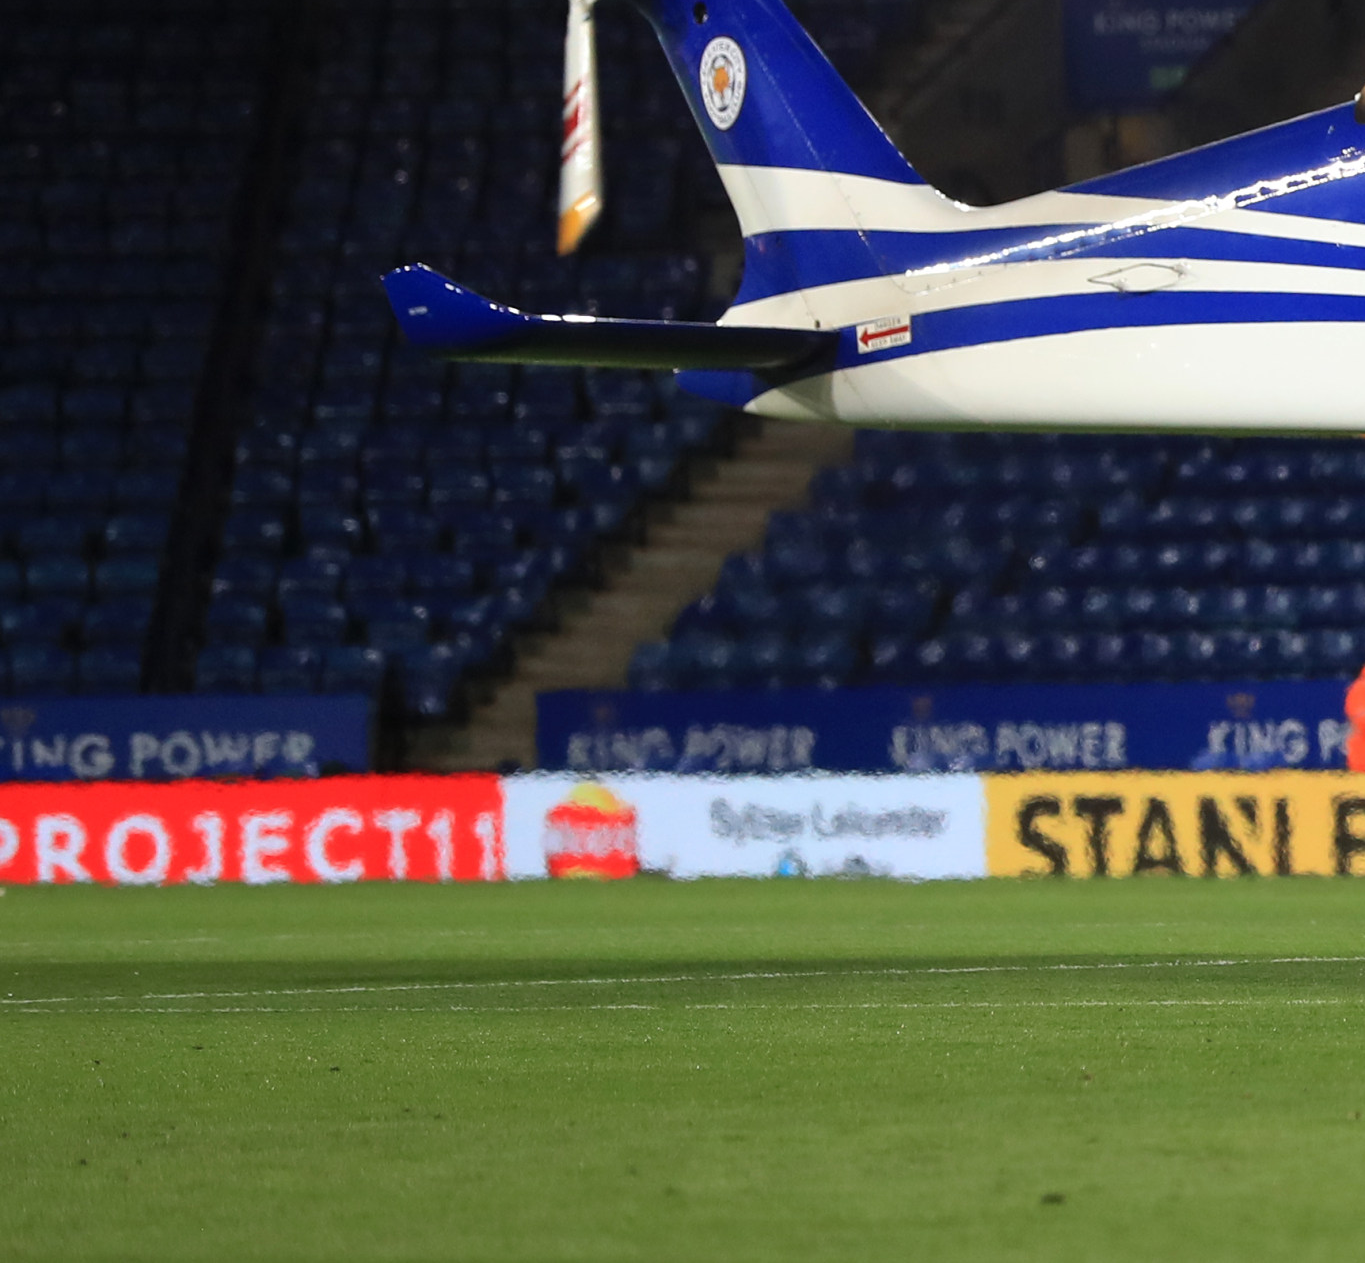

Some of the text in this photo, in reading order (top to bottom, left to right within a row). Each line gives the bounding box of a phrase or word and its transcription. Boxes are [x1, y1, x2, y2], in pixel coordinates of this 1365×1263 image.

[0, 731, 314, 779] ING POWER
[995, 720, 1127, 769] POWER
[1208, 719, 1310, 765] KING
